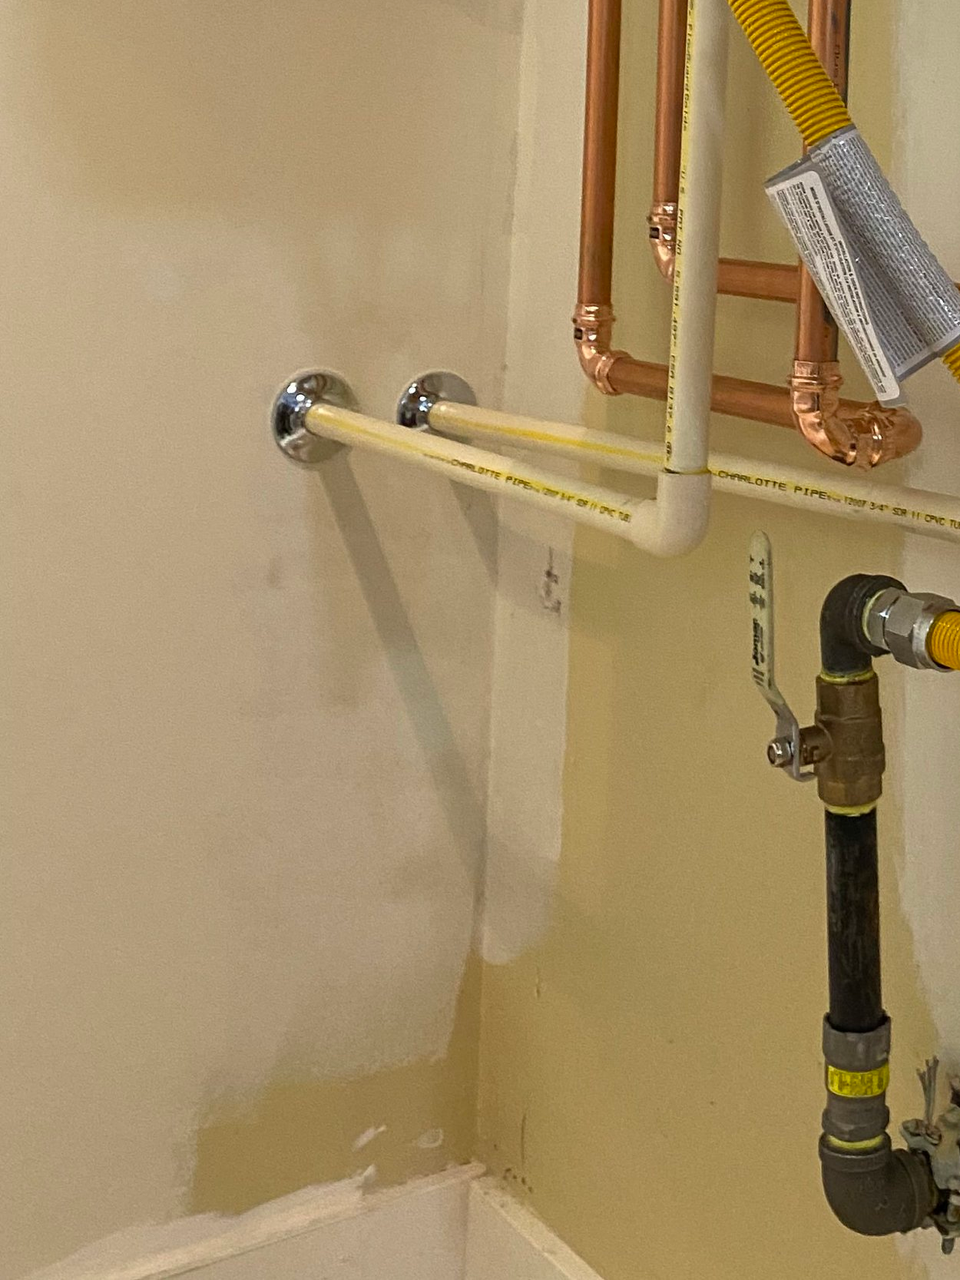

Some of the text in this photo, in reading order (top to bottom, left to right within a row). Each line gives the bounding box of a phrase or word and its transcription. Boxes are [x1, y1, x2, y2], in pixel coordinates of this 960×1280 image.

[451, 458, 502, 480] CHARLOTTE
[506, 475, 533, 491] PIPE
[718, 470, 787, 492] CHARLOTTE
[794, 485, 827, 500] PIPE
[892, 507, 908, 518] SDR
[924, 513, 946, 526] CPVC
